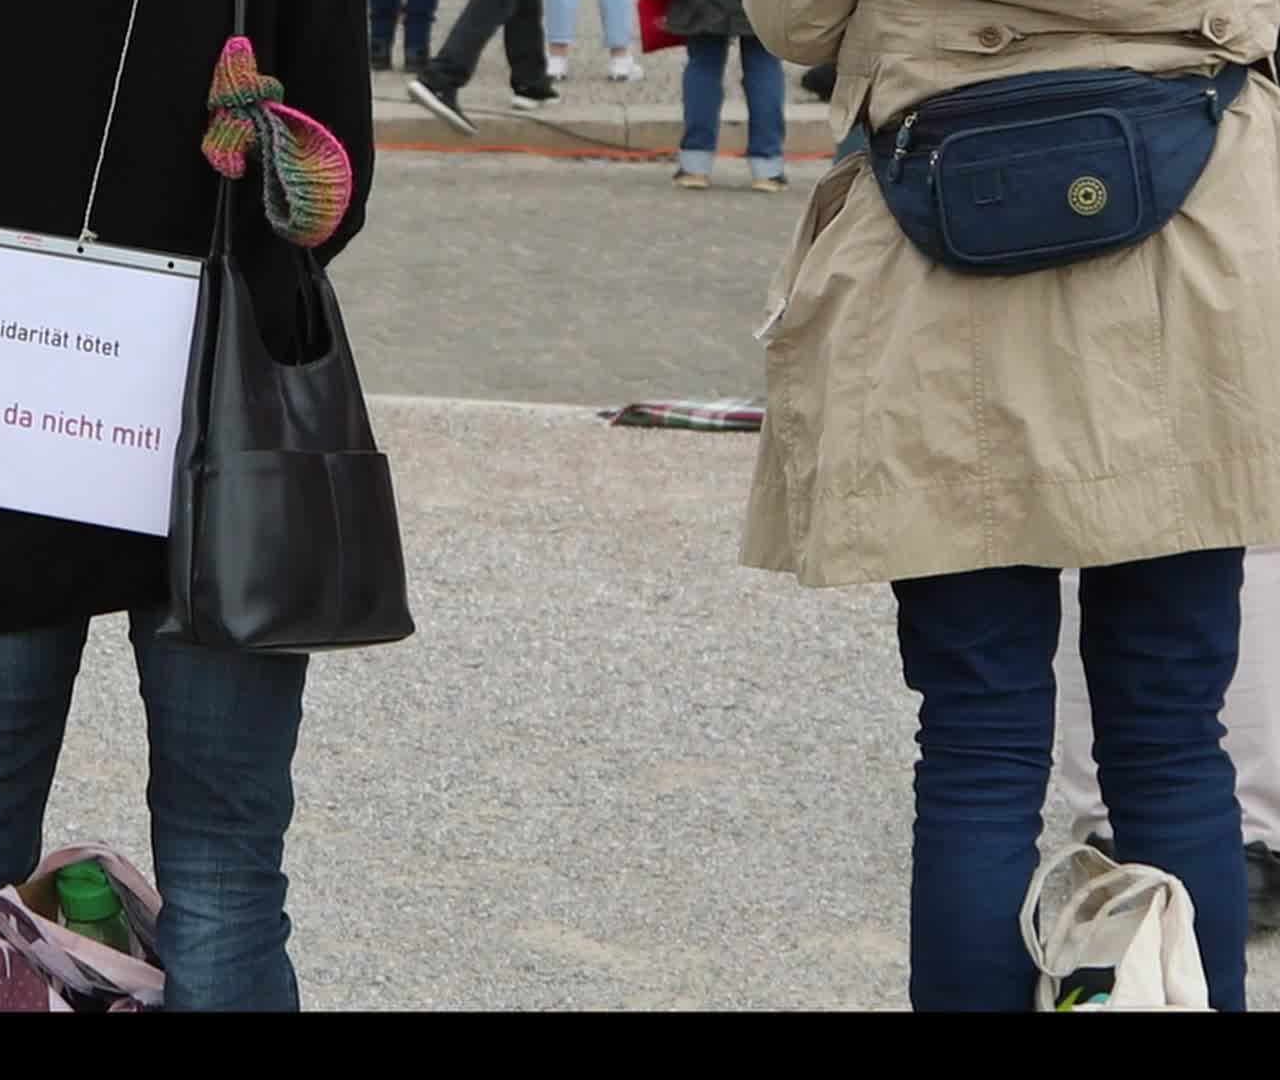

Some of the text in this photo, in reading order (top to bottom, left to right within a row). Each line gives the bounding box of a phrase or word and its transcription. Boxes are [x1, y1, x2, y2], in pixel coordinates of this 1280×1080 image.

[76, 334, 121, 358] tötet
[4, 403, 33, 428] da
[42, 411, 104, 441] nicht
[112, 425, 162, 451] mit!
